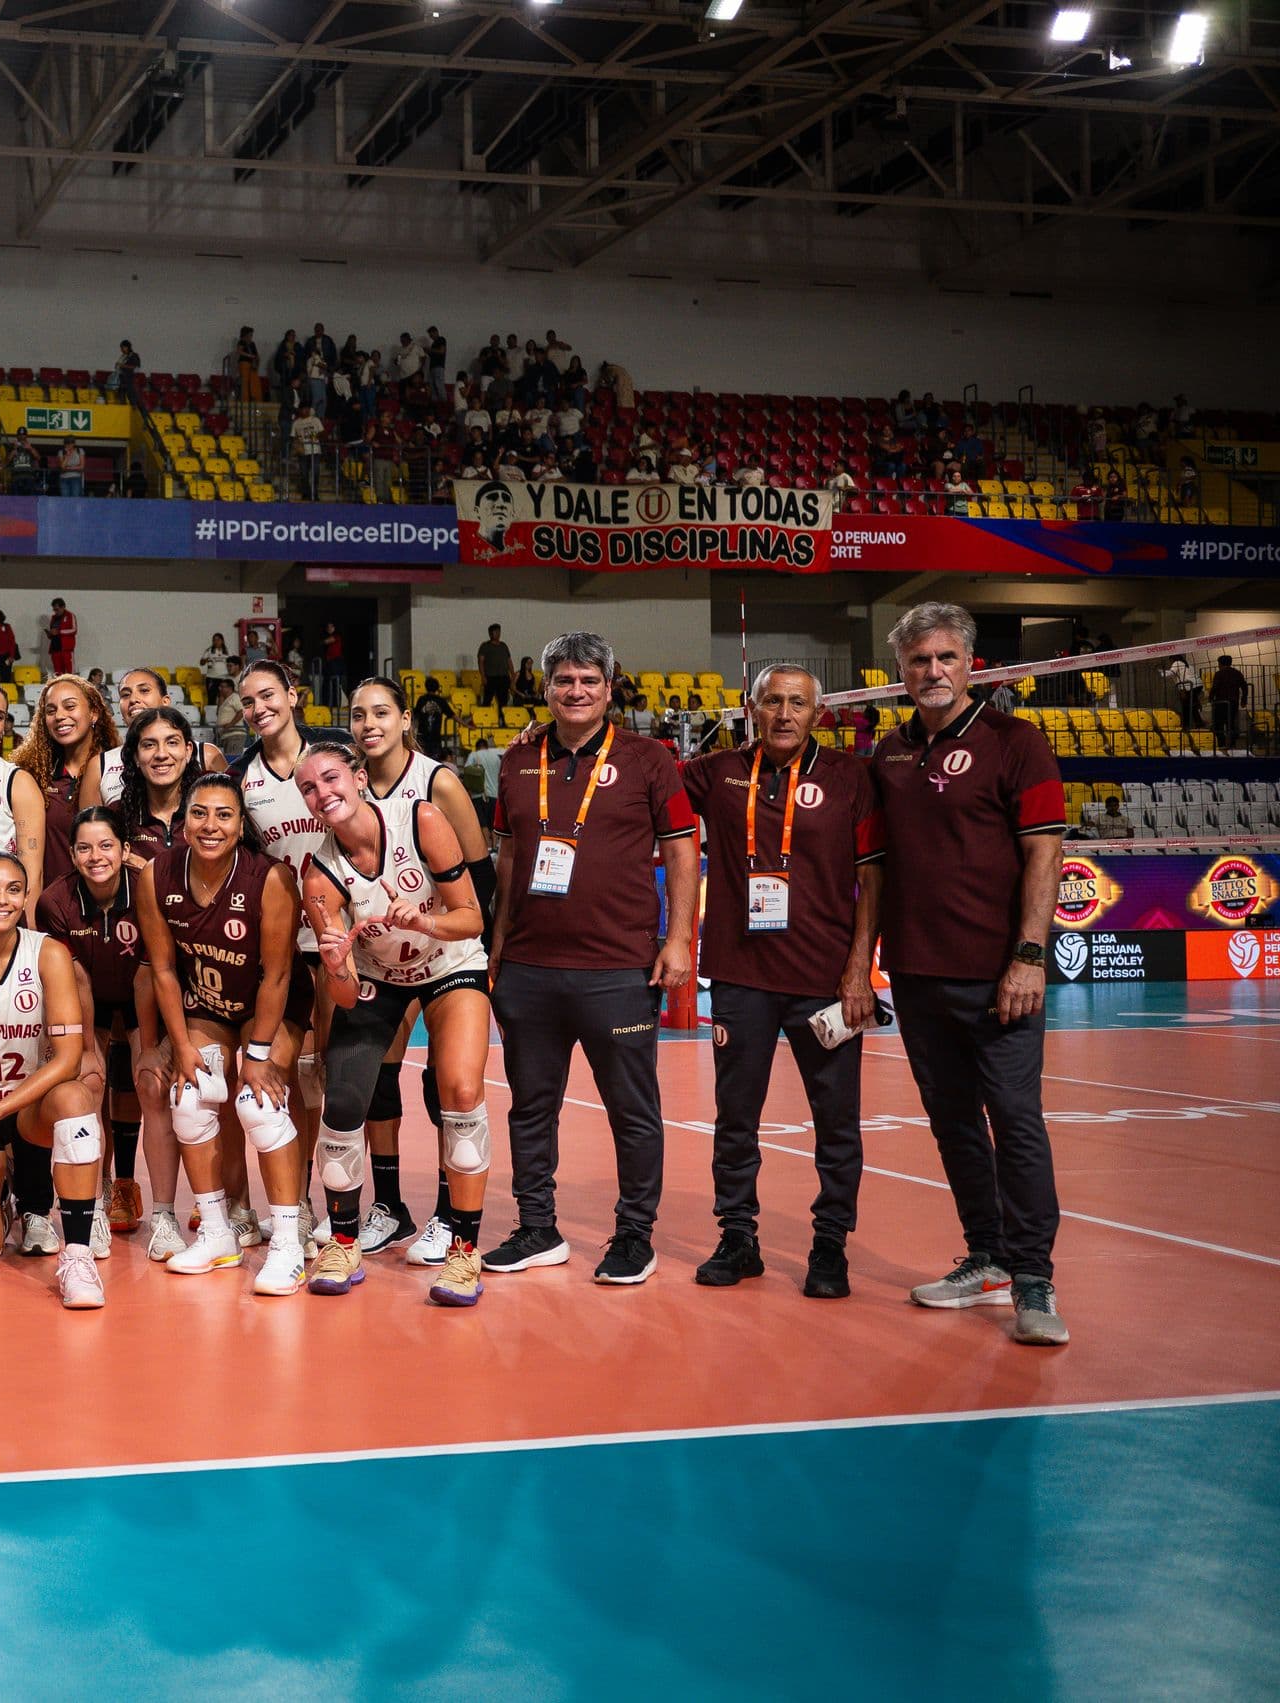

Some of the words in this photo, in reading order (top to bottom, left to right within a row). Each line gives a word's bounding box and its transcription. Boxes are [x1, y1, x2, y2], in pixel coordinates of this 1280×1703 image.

[527, 484, 545, 518] Y
[553, 486, 629, 524] DALE
[679, 486, 717, 522] EN
[727, 487, 819, 527] TODAS
[845, 532, 907, 546] PERUANO
[532, 525, 601, 564] SUS
[608, 527, 816, 568] DISCIPLINAS
[1092, 934, 1116, 944] LIGA
[193, 943, 247, 966] PUMAS
[1092, 945, 1142, 955] PERUANA
[1092, 957, 1112, 967] DE
[1113, 954, 1145, 967] VÓLEY
[1265, 955, 1279, 965] DE
[195, 957, 223, 993] 10
[1093, 968, 1145, 979] betsson
[433, 977, 476, 996] marathon
